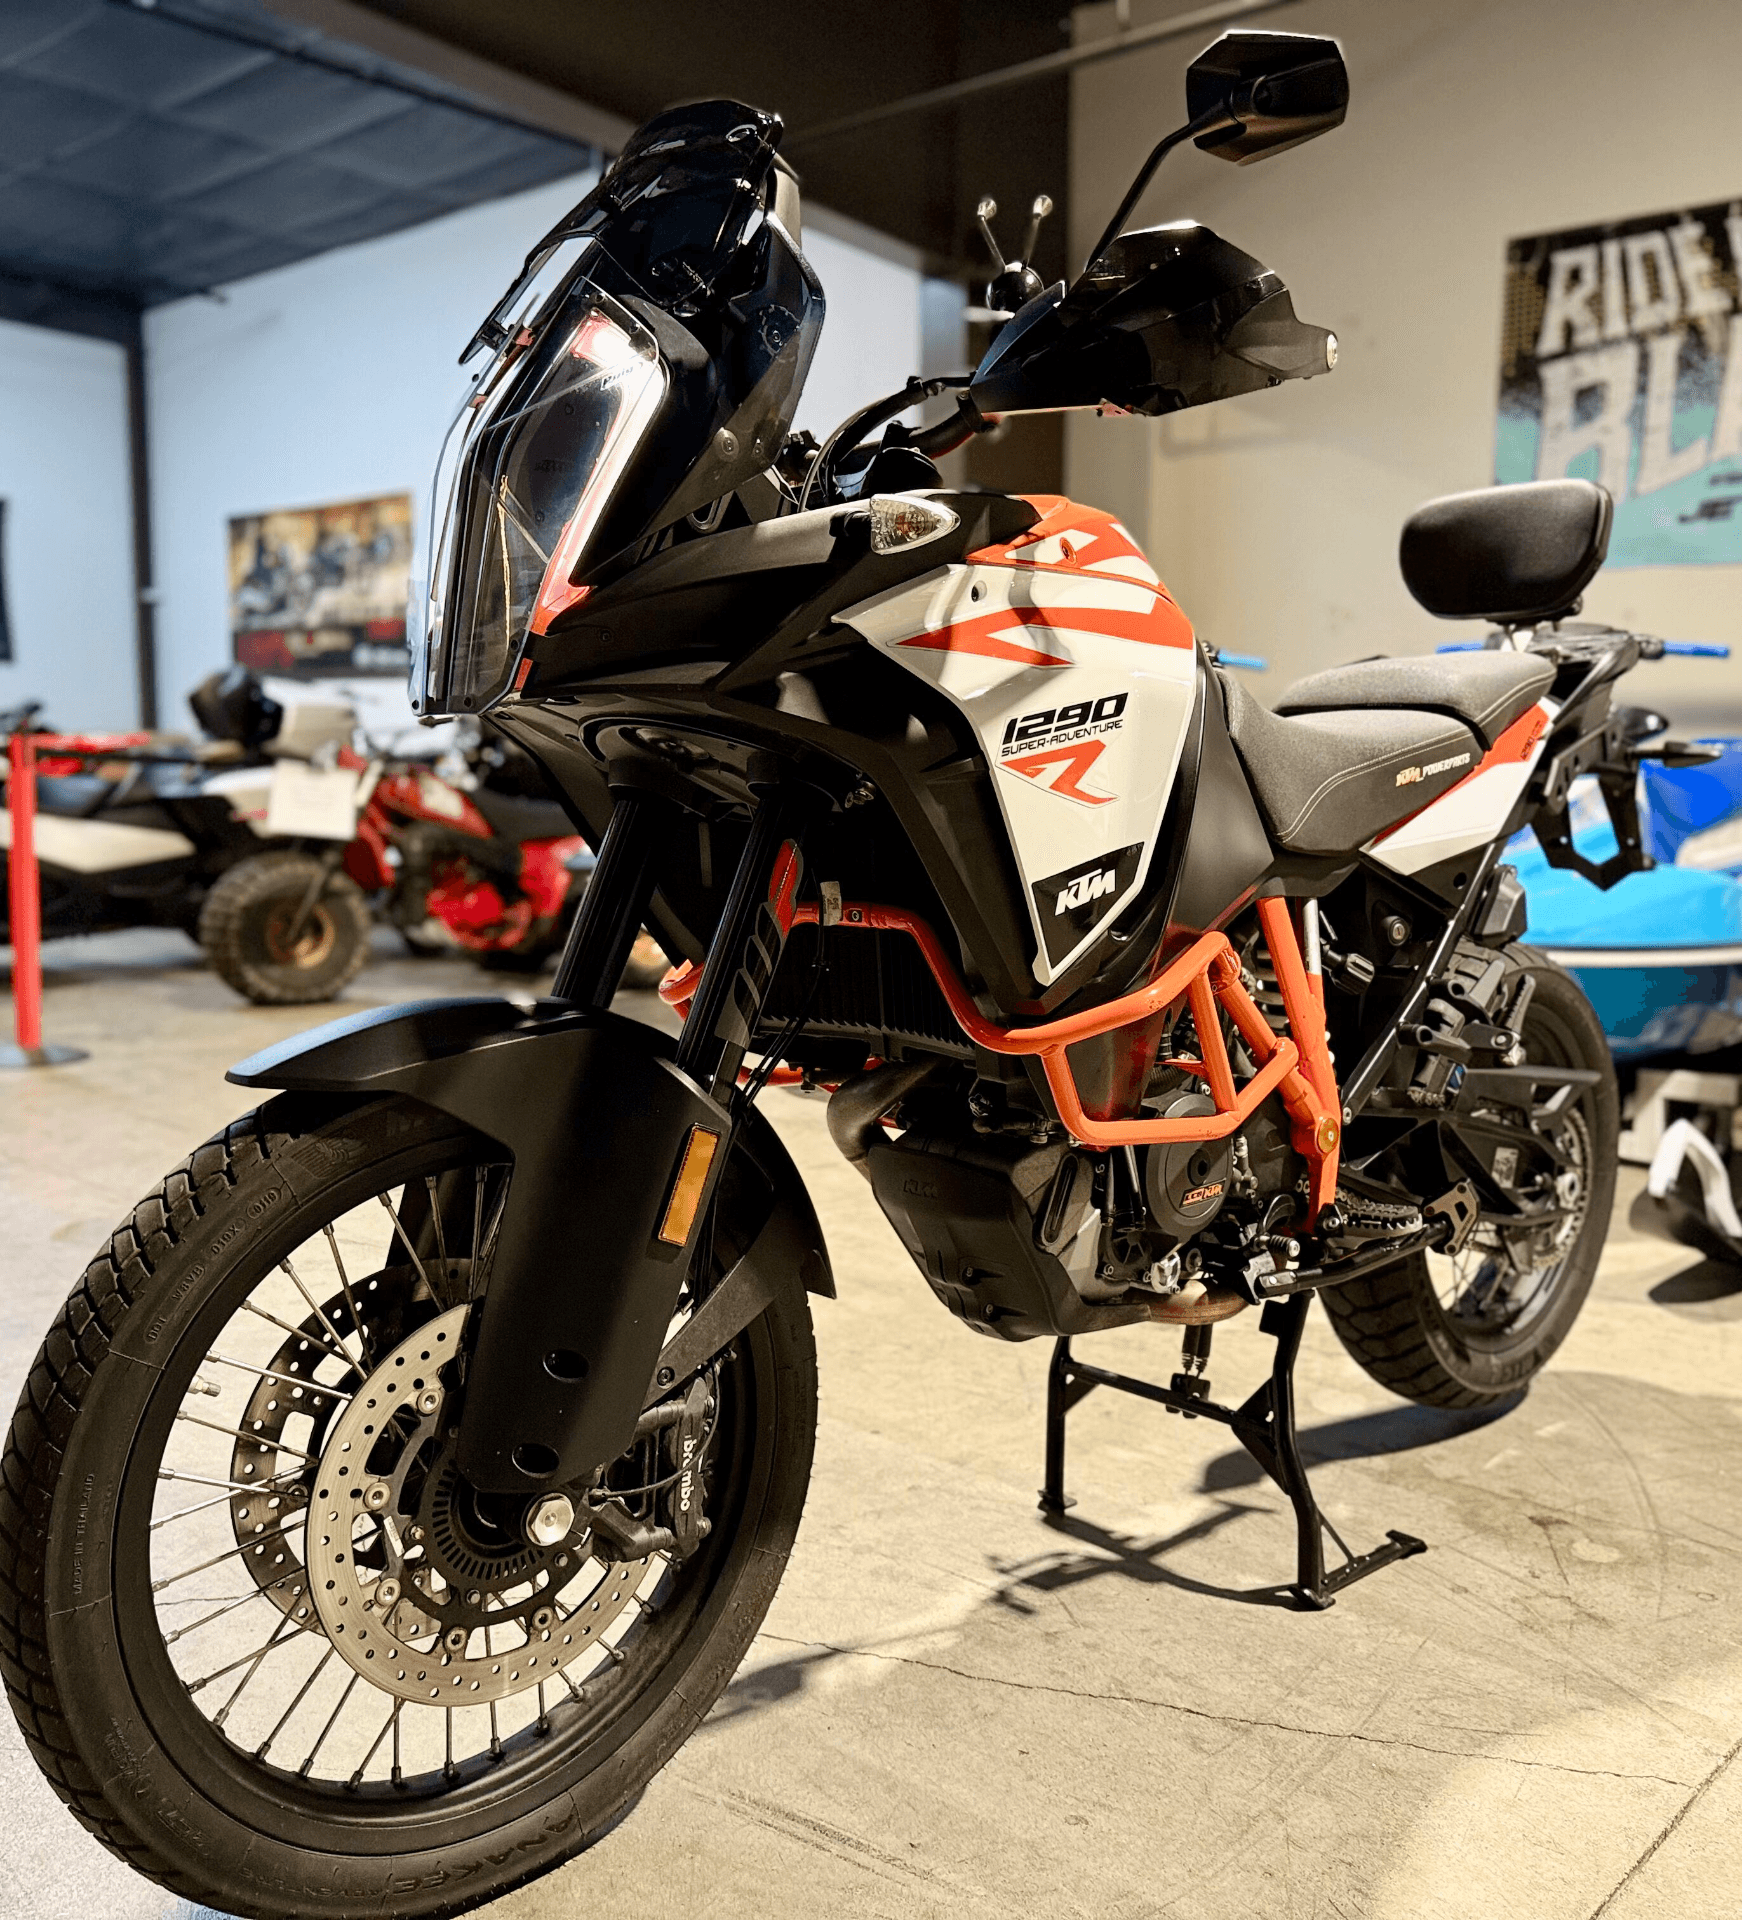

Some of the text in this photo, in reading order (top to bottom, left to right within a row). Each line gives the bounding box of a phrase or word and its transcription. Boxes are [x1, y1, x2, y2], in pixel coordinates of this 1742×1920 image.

[1535, 218, 1733, 354] RIDE
[1001, 719, 1124, 757] SUPER-ADVENTURE
[1002, 692, 1129, 746] 1290
[1000, 739, 1119, 805] R
[1054, 868, 1116, 916] KTM
[73, 1473, 94, 1595] MADE IN THAILAND
[395, 1813, 576, 1895] ANAKEE
